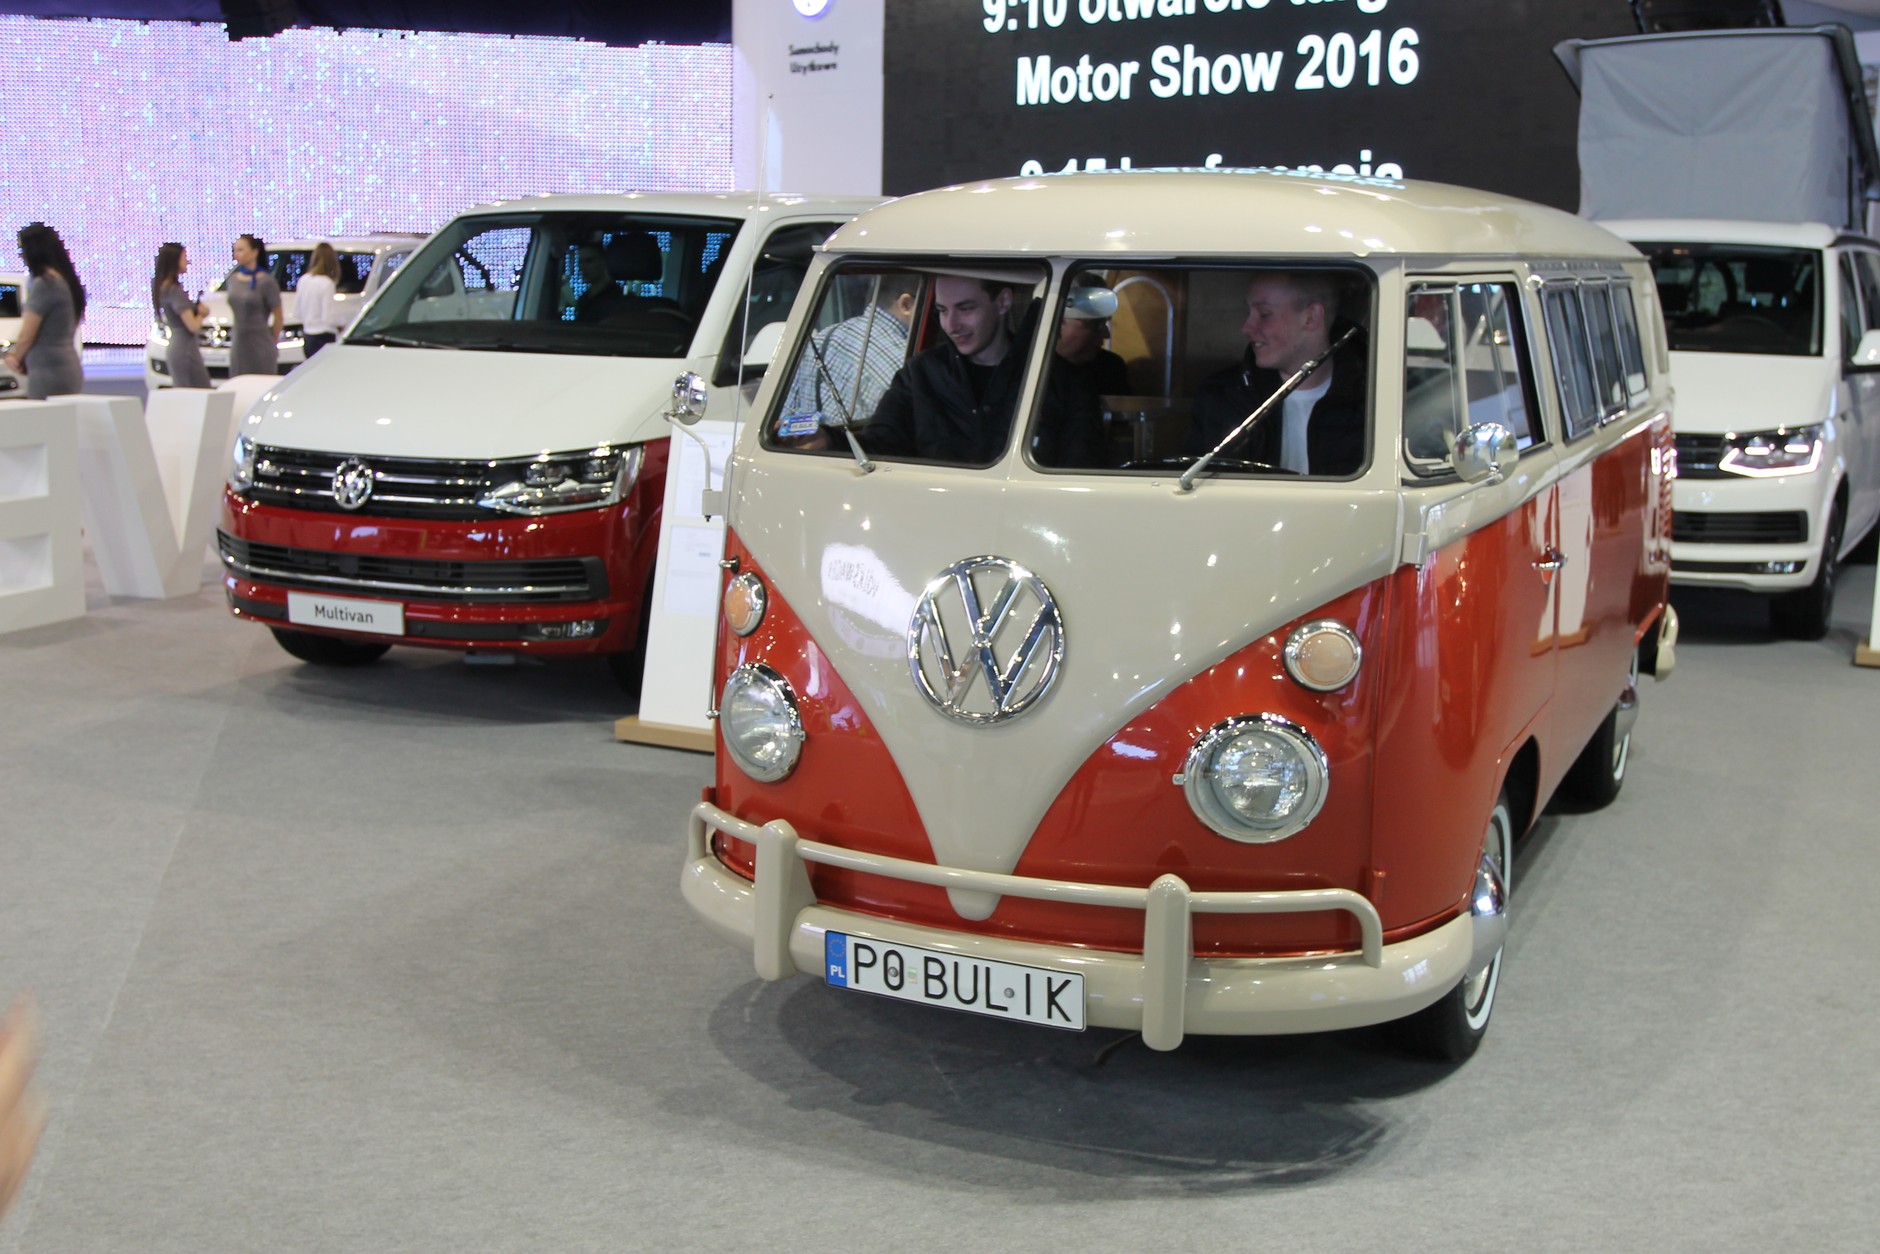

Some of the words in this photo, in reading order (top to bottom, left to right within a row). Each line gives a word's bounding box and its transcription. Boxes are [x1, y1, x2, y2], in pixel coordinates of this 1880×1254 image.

[1016, 54, 1140, 106] Motor
[1149, 43, 1284, 98] Show
[1294, 27, 1420, 90] 2016
[314, 604, 374, 624] Multivan
[830, 964, 845, 978] PL
